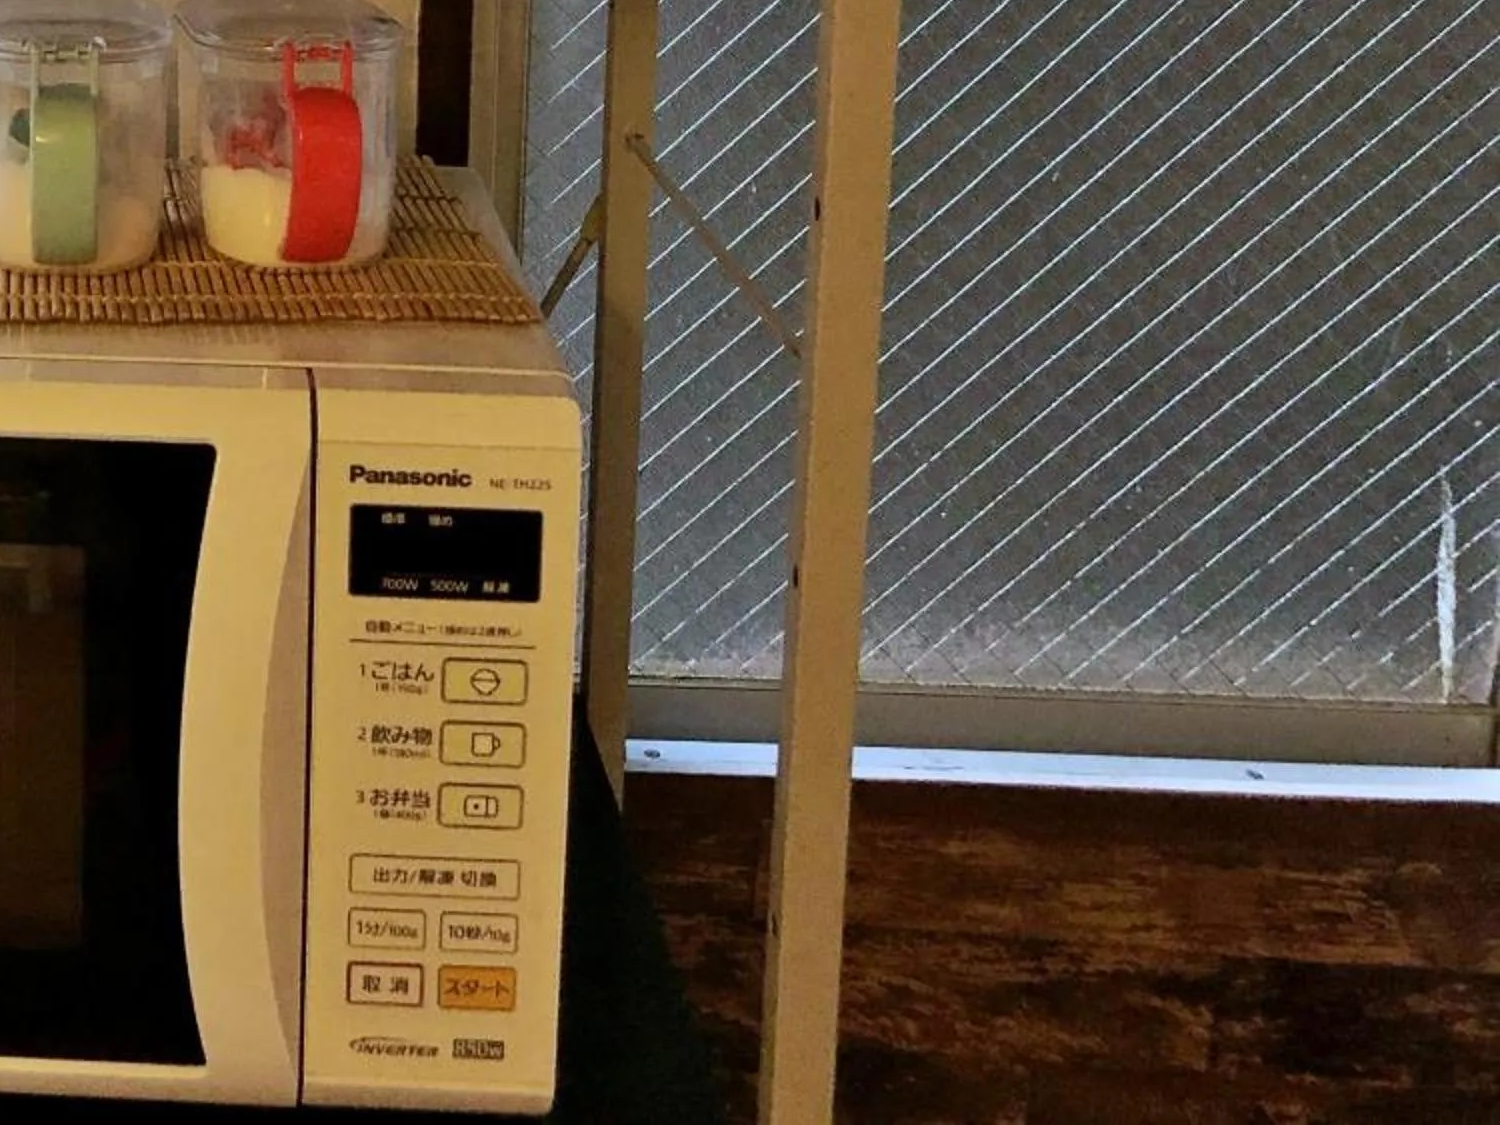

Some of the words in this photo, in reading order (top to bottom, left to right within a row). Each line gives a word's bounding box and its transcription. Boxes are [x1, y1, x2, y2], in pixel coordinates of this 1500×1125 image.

[350, 465, 473, 488] Panasonic
[371, 660, 435, 682] ごはん
[371, 725, 433, 746] 飲み物
[369, 788, 431, 809] お弁当
[444, 977, 510, 997] スタート
